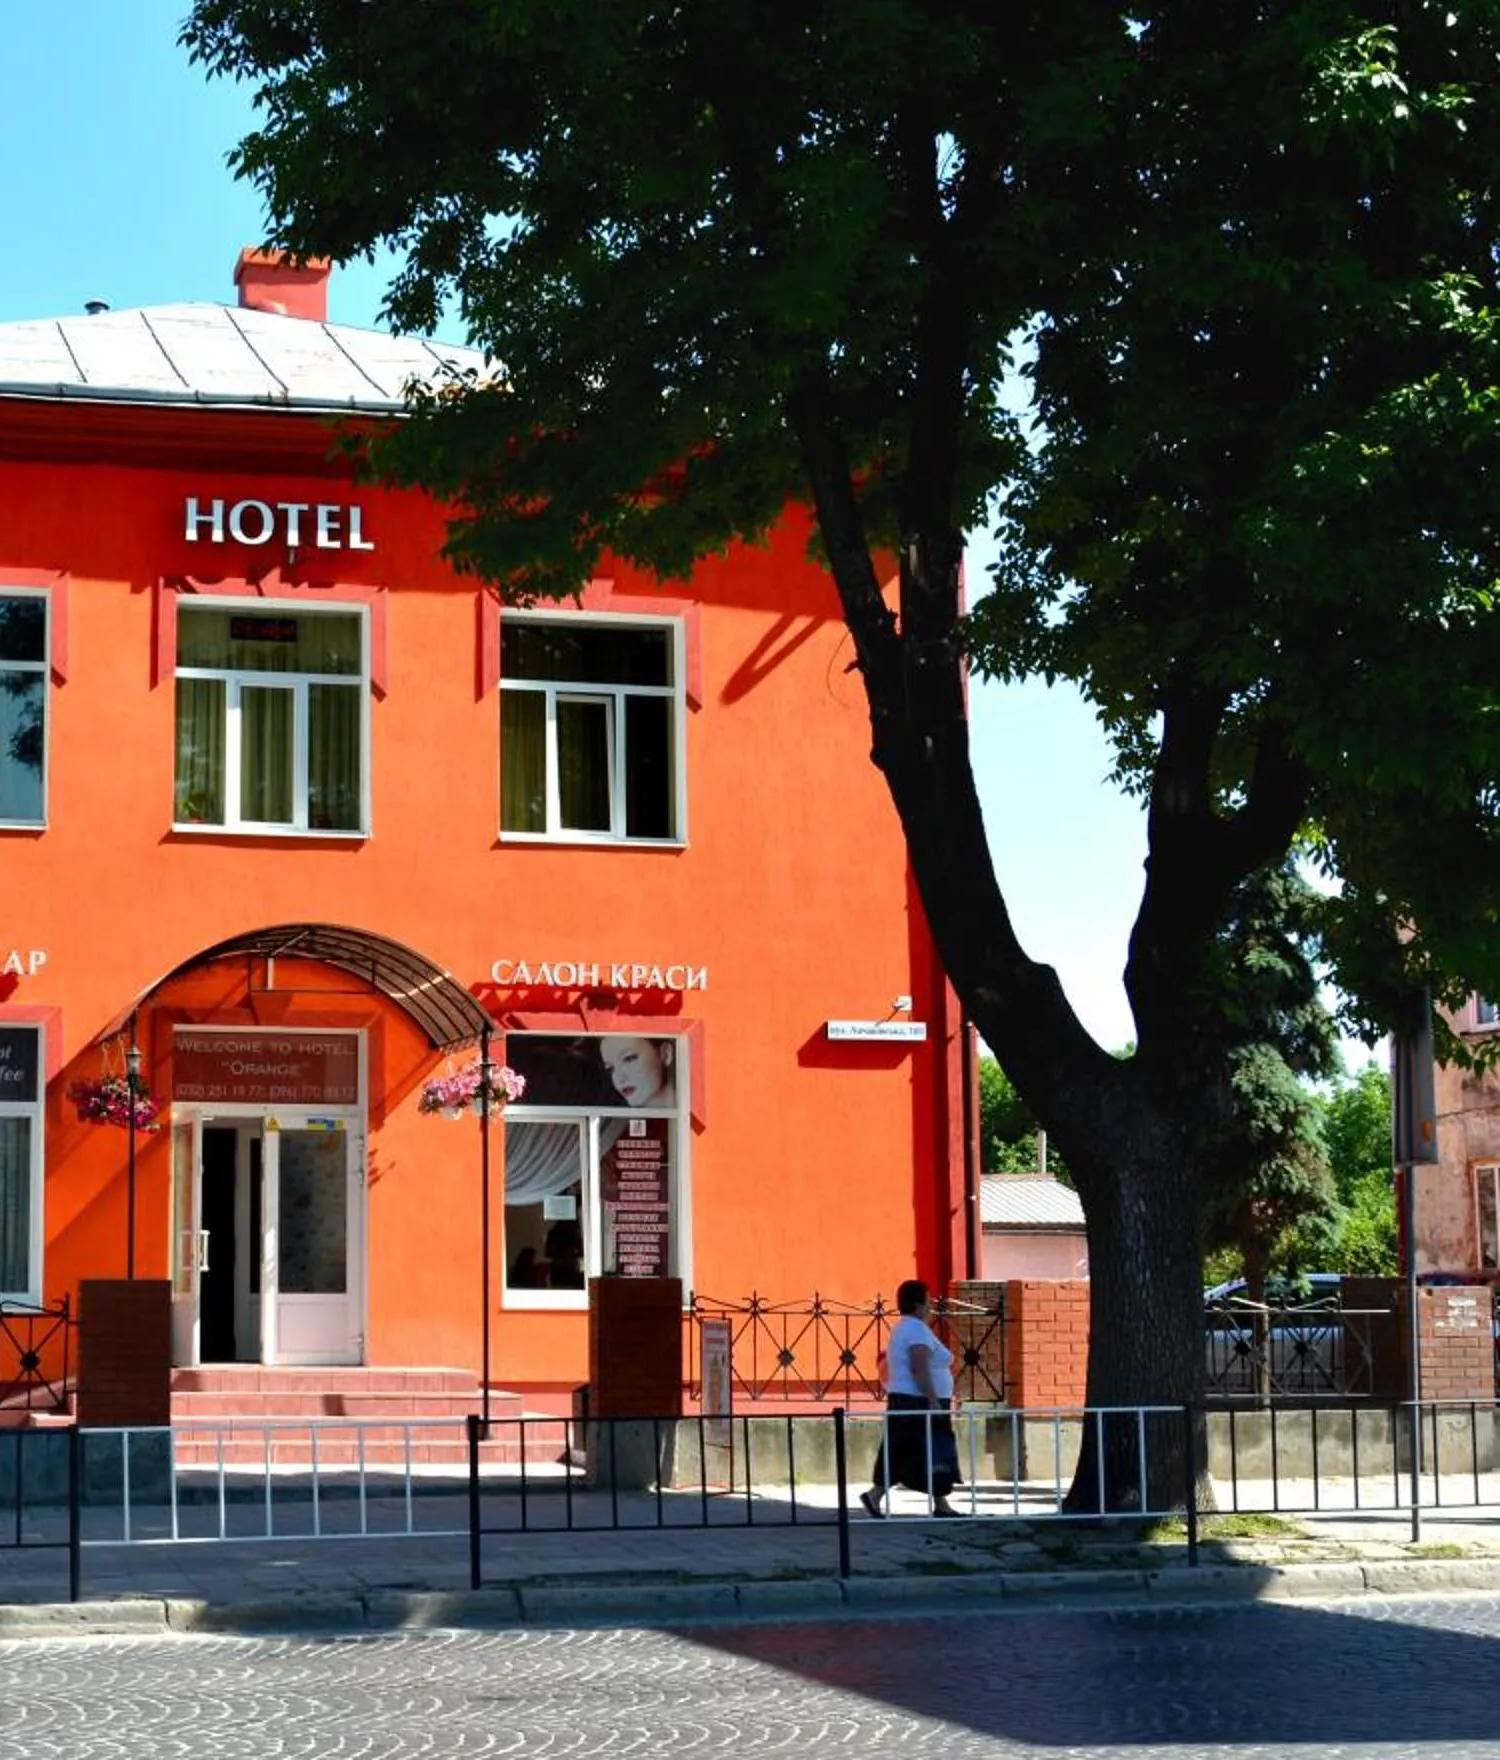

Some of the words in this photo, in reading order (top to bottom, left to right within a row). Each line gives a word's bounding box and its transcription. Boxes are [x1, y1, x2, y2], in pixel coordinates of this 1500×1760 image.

[185, 497, 375, 550] HOTEL
[491, 959, 600, 987] САЛОН
[611, 963, 708, 991] КРАСИ
[176, 1038, 261, 1054] WELCOME
[300, 1042, 355, 1056] HOTEL
